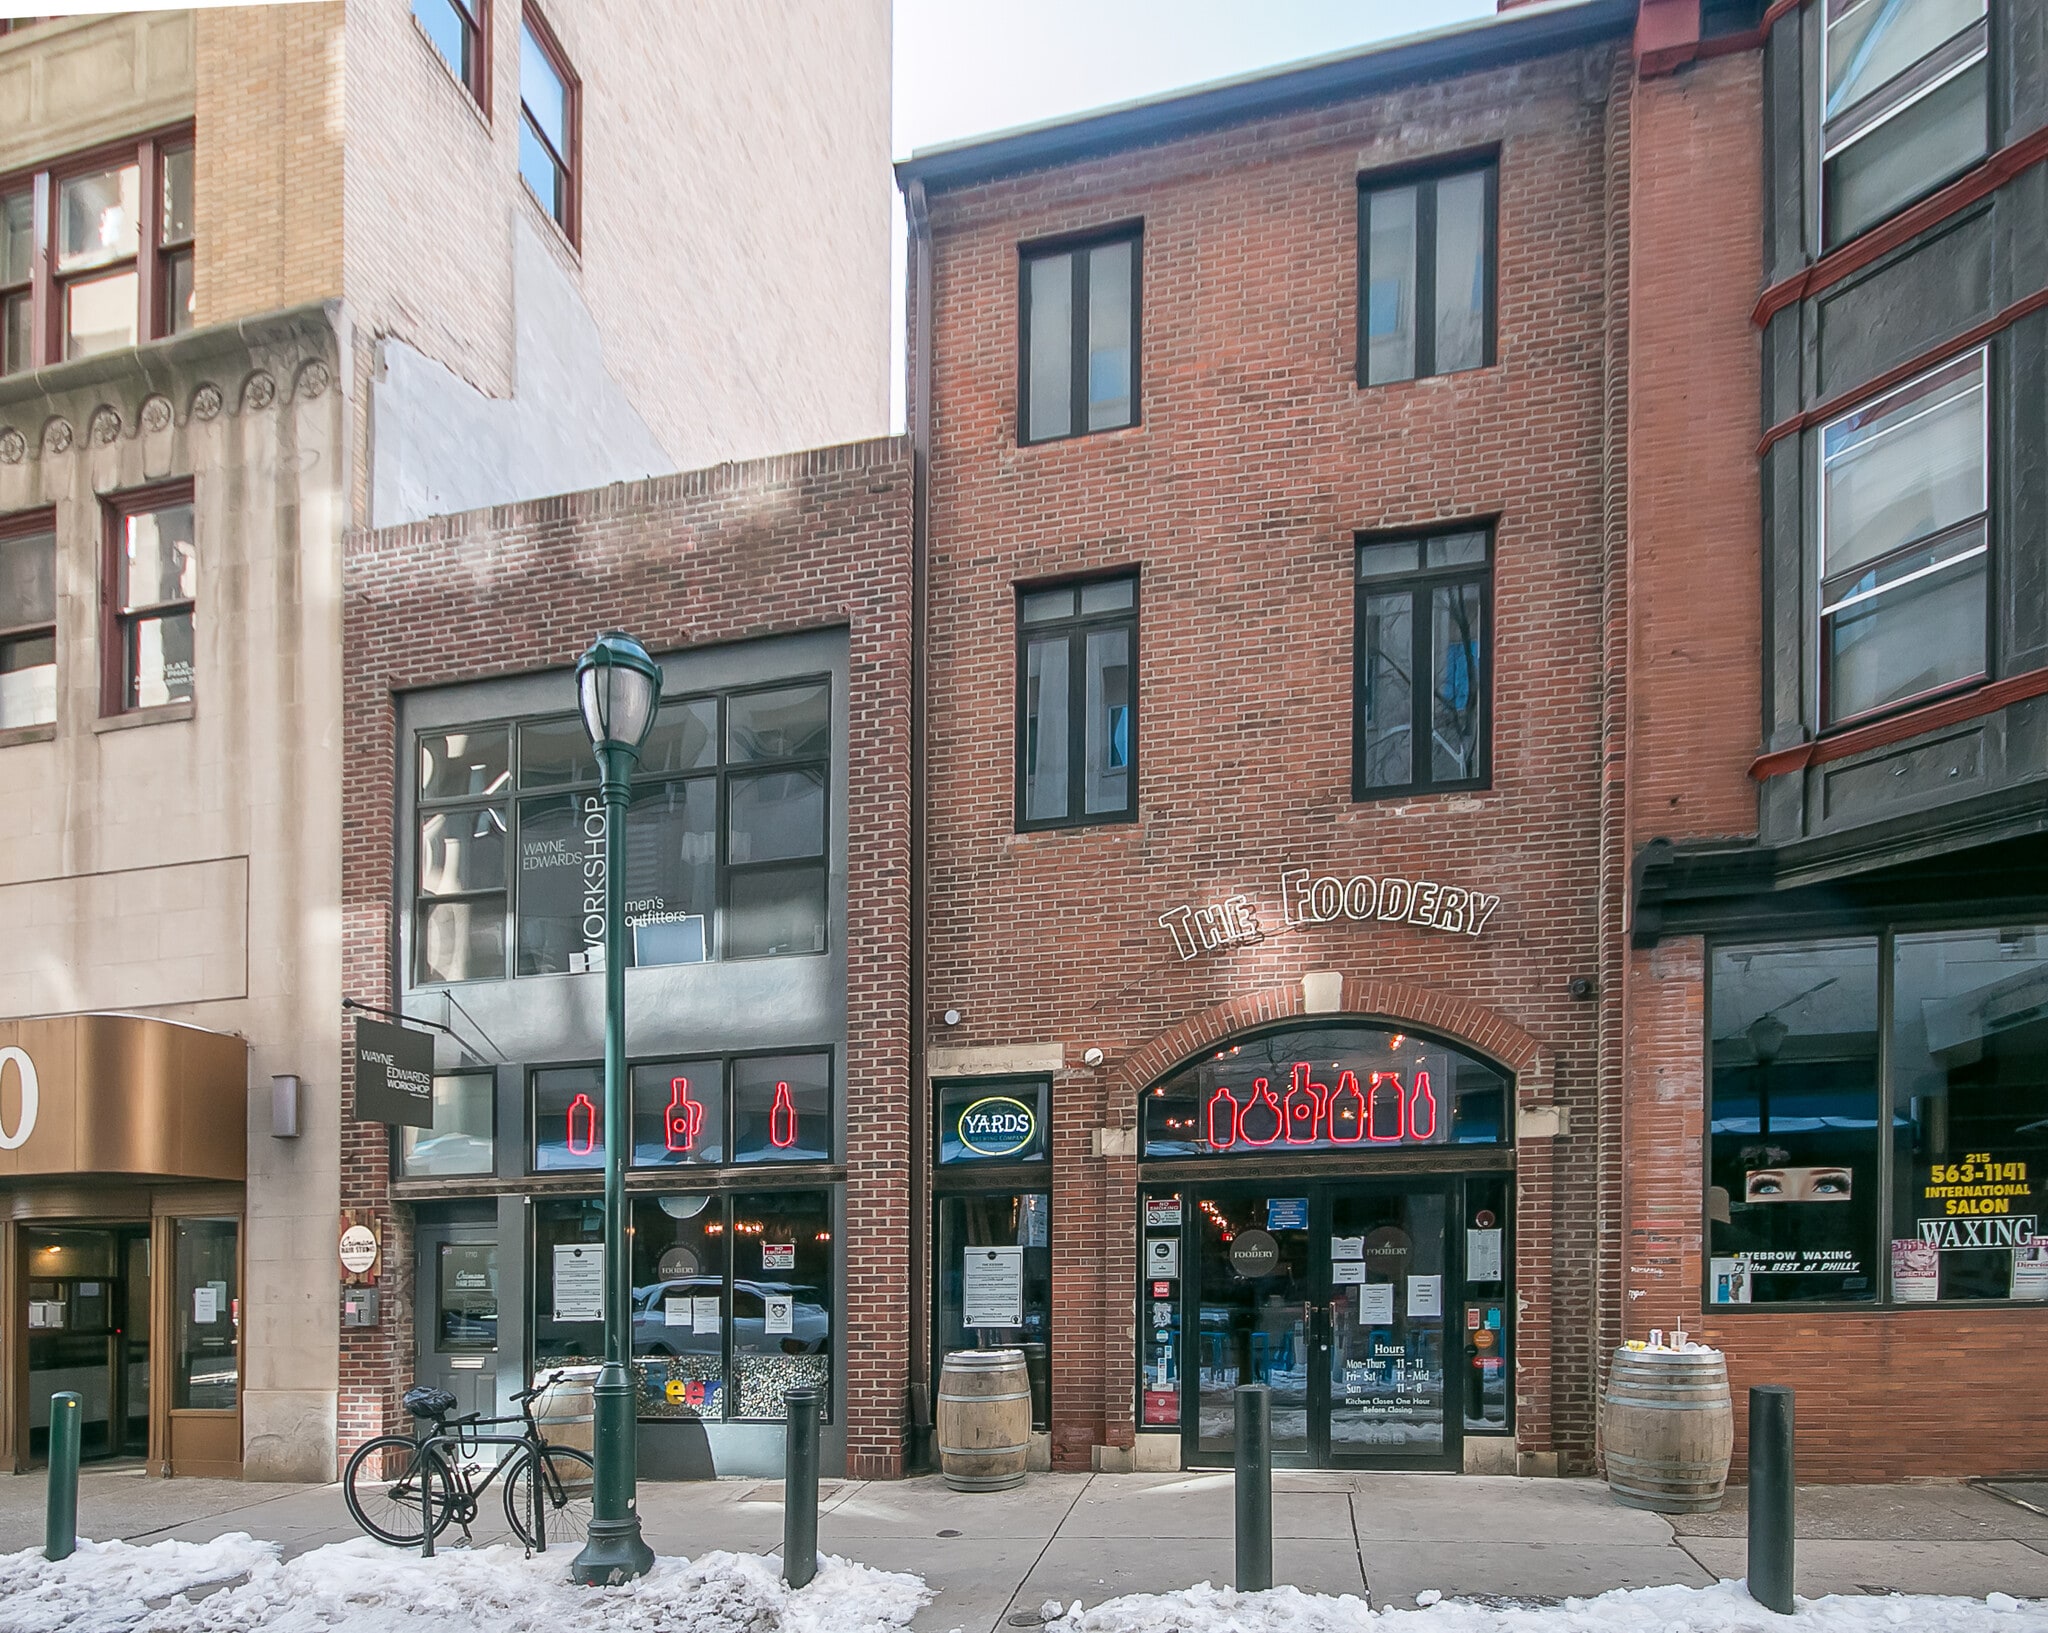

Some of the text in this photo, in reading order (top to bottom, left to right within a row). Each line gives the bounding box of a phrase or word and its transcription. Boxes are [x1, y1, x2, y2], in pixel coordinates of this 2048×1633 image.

[523, 839, 566, 856] WAYNE
[523, 852, 582, 870] EDWARDS
[625, 896, 664, 912] men's
[625, 910, 687, 928] outfitters
[1158, 868, 1500, 961] THE FOODERY
[361, 1049, 394, 1066] WAYNE
[387, 1066, 430, 1084] EDWARDS
[387, 1079, 430, 1093] WORKSHOP
[965, 1114, 1029, 1133] YARDS
[1965, 1153, 1990, 1163] 215
[1931, 1163, 2026, 1183] 563-1141
[1925, 1184, 2031, 1198] INTERNATIONAL
[1946, 1198, 2009, 1215] SALON
[1920, 1219, 2034, 1248] WAXING
[1234, 1250, 1273, 1258] FOODERY
[1739, 1251, 1852, 1260] EYEBROW WAXING
[1749, 1263, 1767, 1271] the
[1772, 1263, 1800, 1271] BEST
[1804, 1263, 1817, 1271] of
[1821, 1262, 1860, 1271] PHILLY
[1374, 1344, 1405, 1354] Hours
[1346, 1358, 1386, 1369] Mon-Thurs
[1346, 1384, 1361, 1393] Sun
[1345, 1397, 1431, 1405] Kitchen Closes One Hour
[1387, 1406, 1413, 1414] Closing
